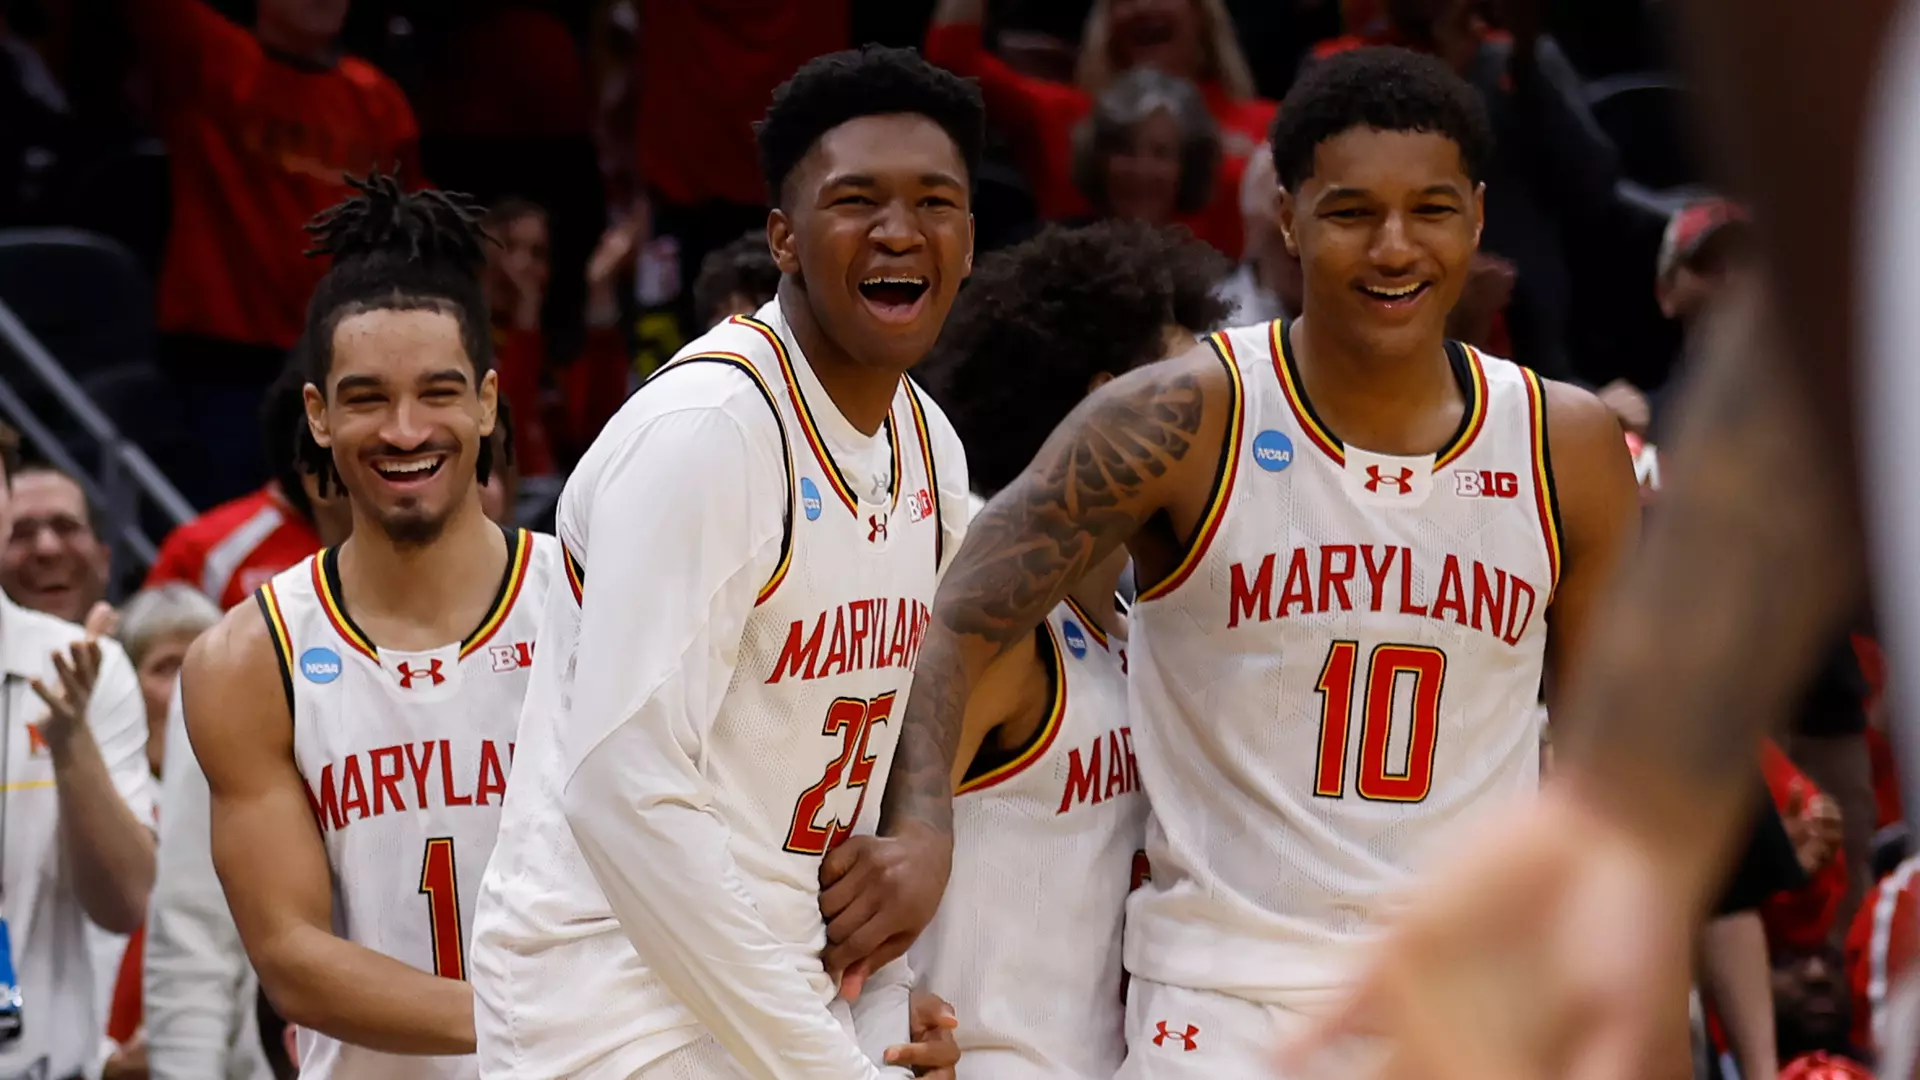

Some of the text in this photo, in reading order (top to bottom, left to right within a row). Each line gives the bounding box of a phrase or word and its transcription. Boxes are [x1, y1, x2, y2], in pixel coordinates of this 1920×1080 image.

[1257, 447, 1290, 462] NCAA
[1227, 544, 1536, 647] MARYLAND
[782, 690, 897, 856] 25
[1313, 640, 1447, 803] 10
[304, 739, 515, 832] MARYLA
[418, 837, 466, 981] 1
